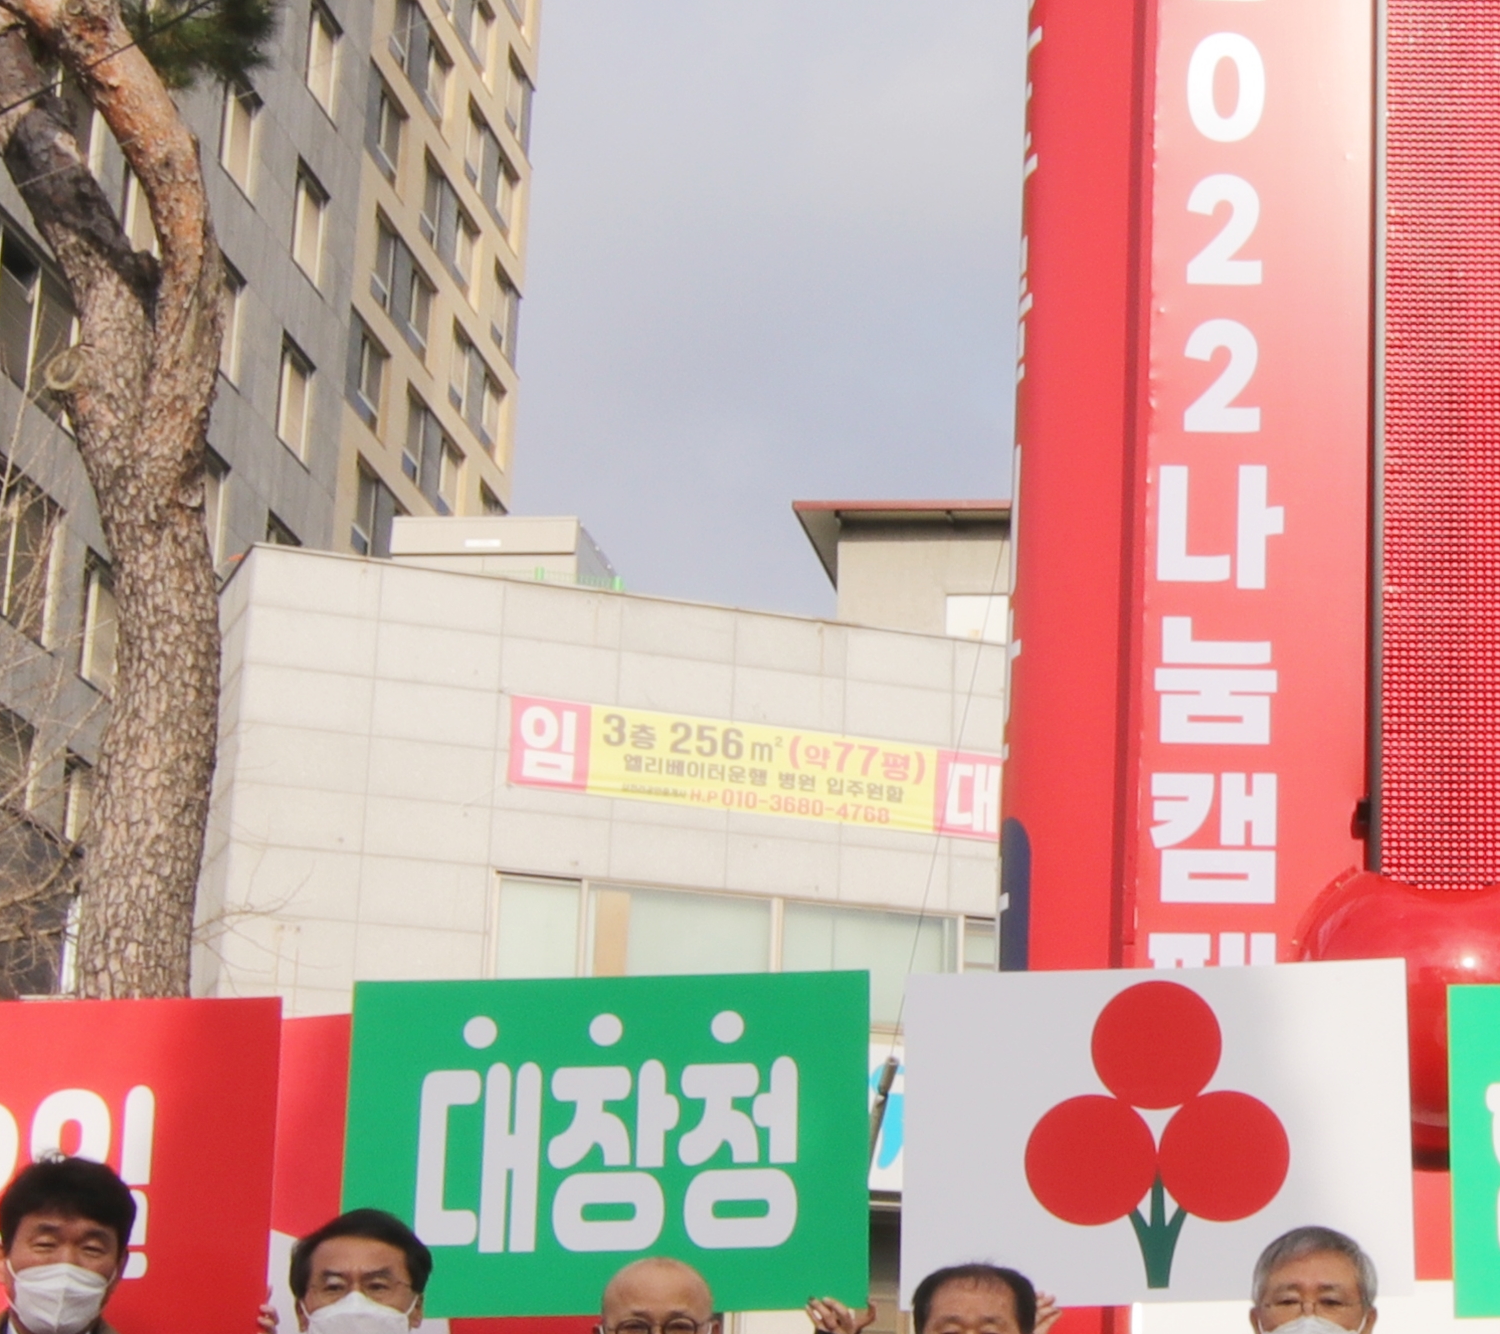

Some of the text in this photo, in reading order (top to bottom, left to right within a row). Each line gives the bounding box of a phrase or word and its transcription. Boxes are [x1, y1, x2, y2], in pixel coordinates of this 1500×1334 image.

[520, 705, 577, 782] 임
[602, 713, 657, 750] 3층
[788, 735, 926, 785] (약77평)
[721, 789, 890, 825] 010-3680-4768
[779, 770, 816, 792] 병원
[945, 761, 1002, 833] 대
[414, 1056, 798, 1254] 대장정
